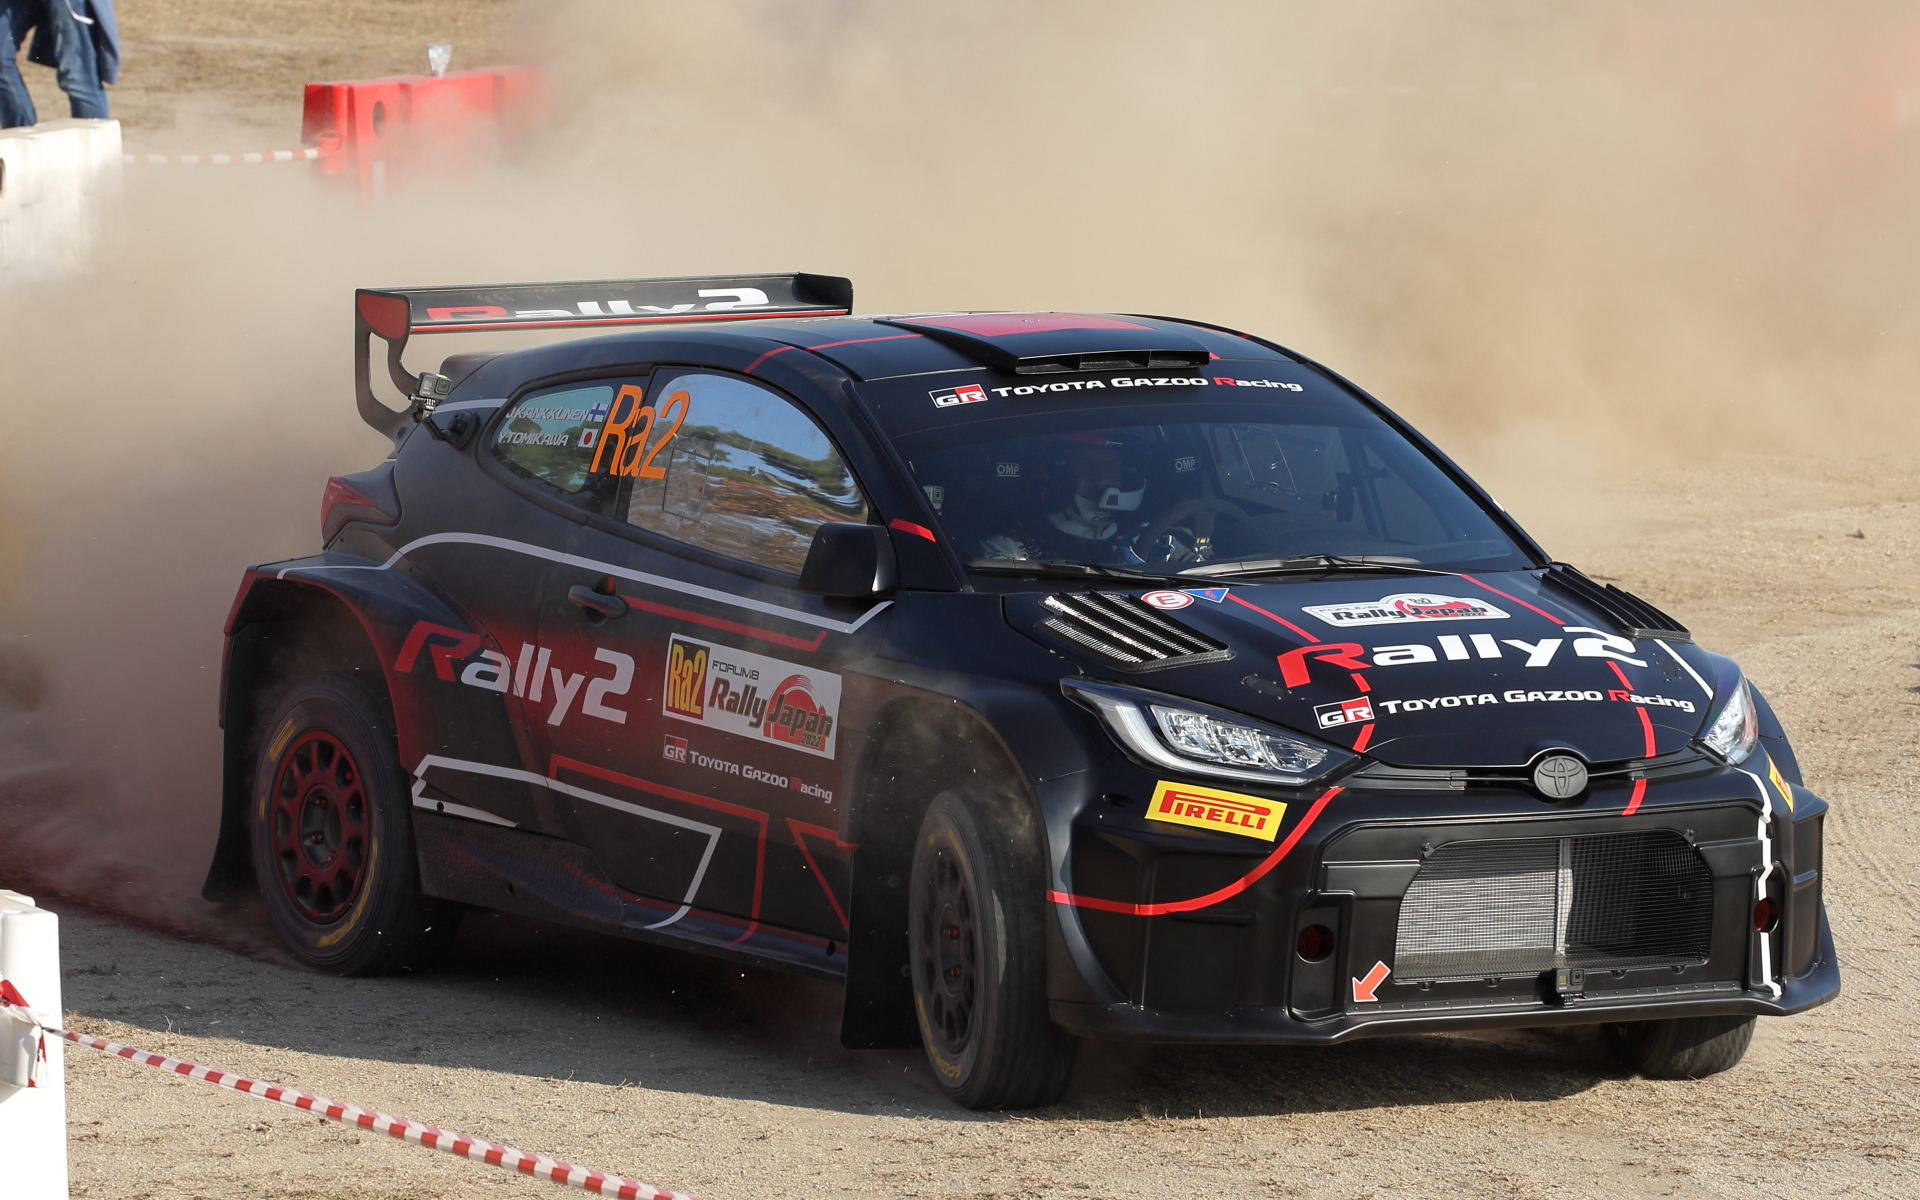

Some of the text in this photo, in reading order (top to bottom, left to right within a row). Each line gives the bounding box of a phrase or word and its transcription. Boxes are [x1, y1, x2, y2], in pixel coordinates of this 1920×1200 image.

[936, 376, 1303, 406] GR TOYOTA GAZOO Racing
[506, 407, 590, 421] J.KANKKUNEN
[498, 430, 569, 447] Y.TOMIKAWA
[590, 384, 690, 480] Ra2
[997, 464, 1020, 475] OMP
[1175, 458, 1195, 471] OMP
[1331, 605, 1488, 620] Rally Japan
[394, 620, 635, 726] Rally2
[711, 659, 760, 681] FORUM8
[1277, 626, 1648, 688] Rally2
[668, 643, 707, 715] Ra2
[708, 676, 833, 739] Rally Japan
[1320, 689, 1696, 726] GR TOYOTA GAZOO Racing
[800, 732, 821, 748] 2022
[664, 744, 833, 804] GR TOYOTA GAZOO Racing
[1158, 789, 1272, 830] PIRELLI
